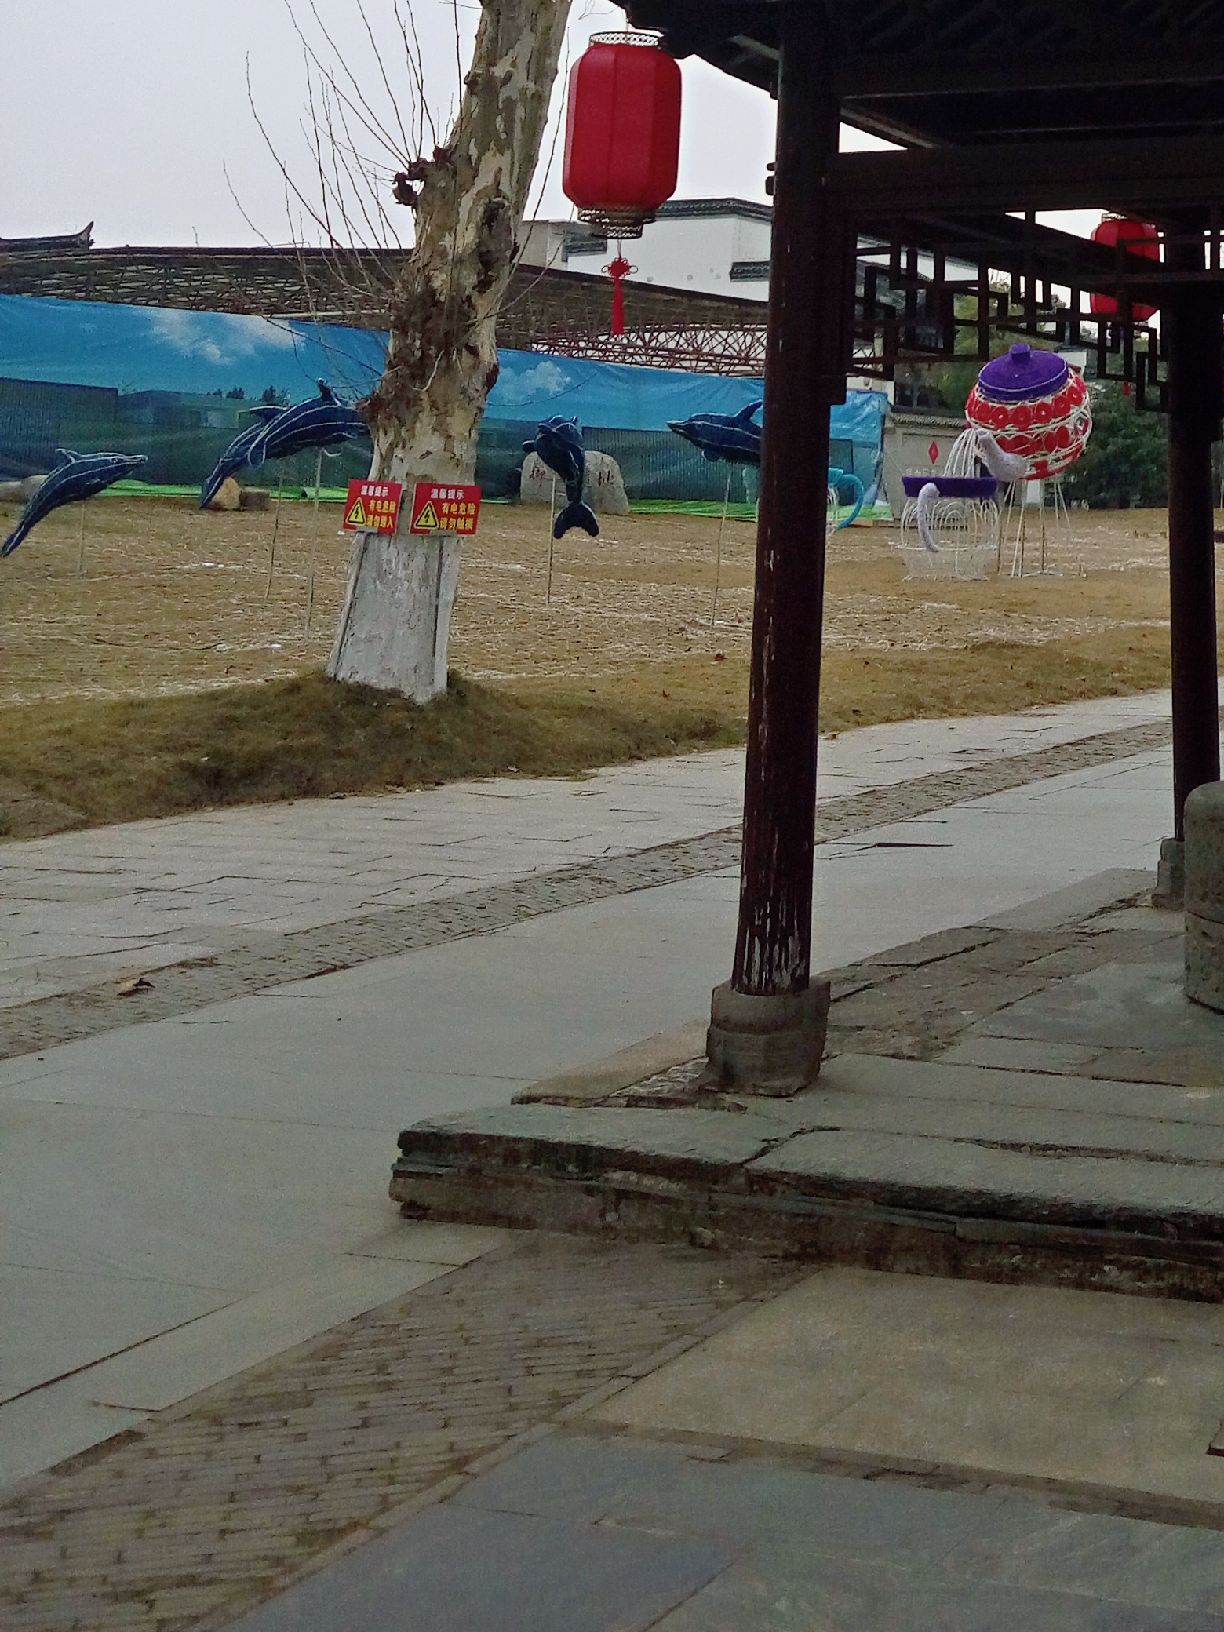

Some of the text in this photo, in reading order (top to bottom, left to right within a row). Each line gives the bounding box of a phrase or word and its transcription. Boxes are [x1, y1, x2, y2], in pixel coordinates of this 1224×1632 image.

[360, 485, 389, 498] 温馨提示
[430, 488, 465, 500] 温馨提示
[369, 499, 396, 514] 有电危险
[442, 502, 476, 515] 有电危险
[439, 517, 474, 530] 请勿触摸
